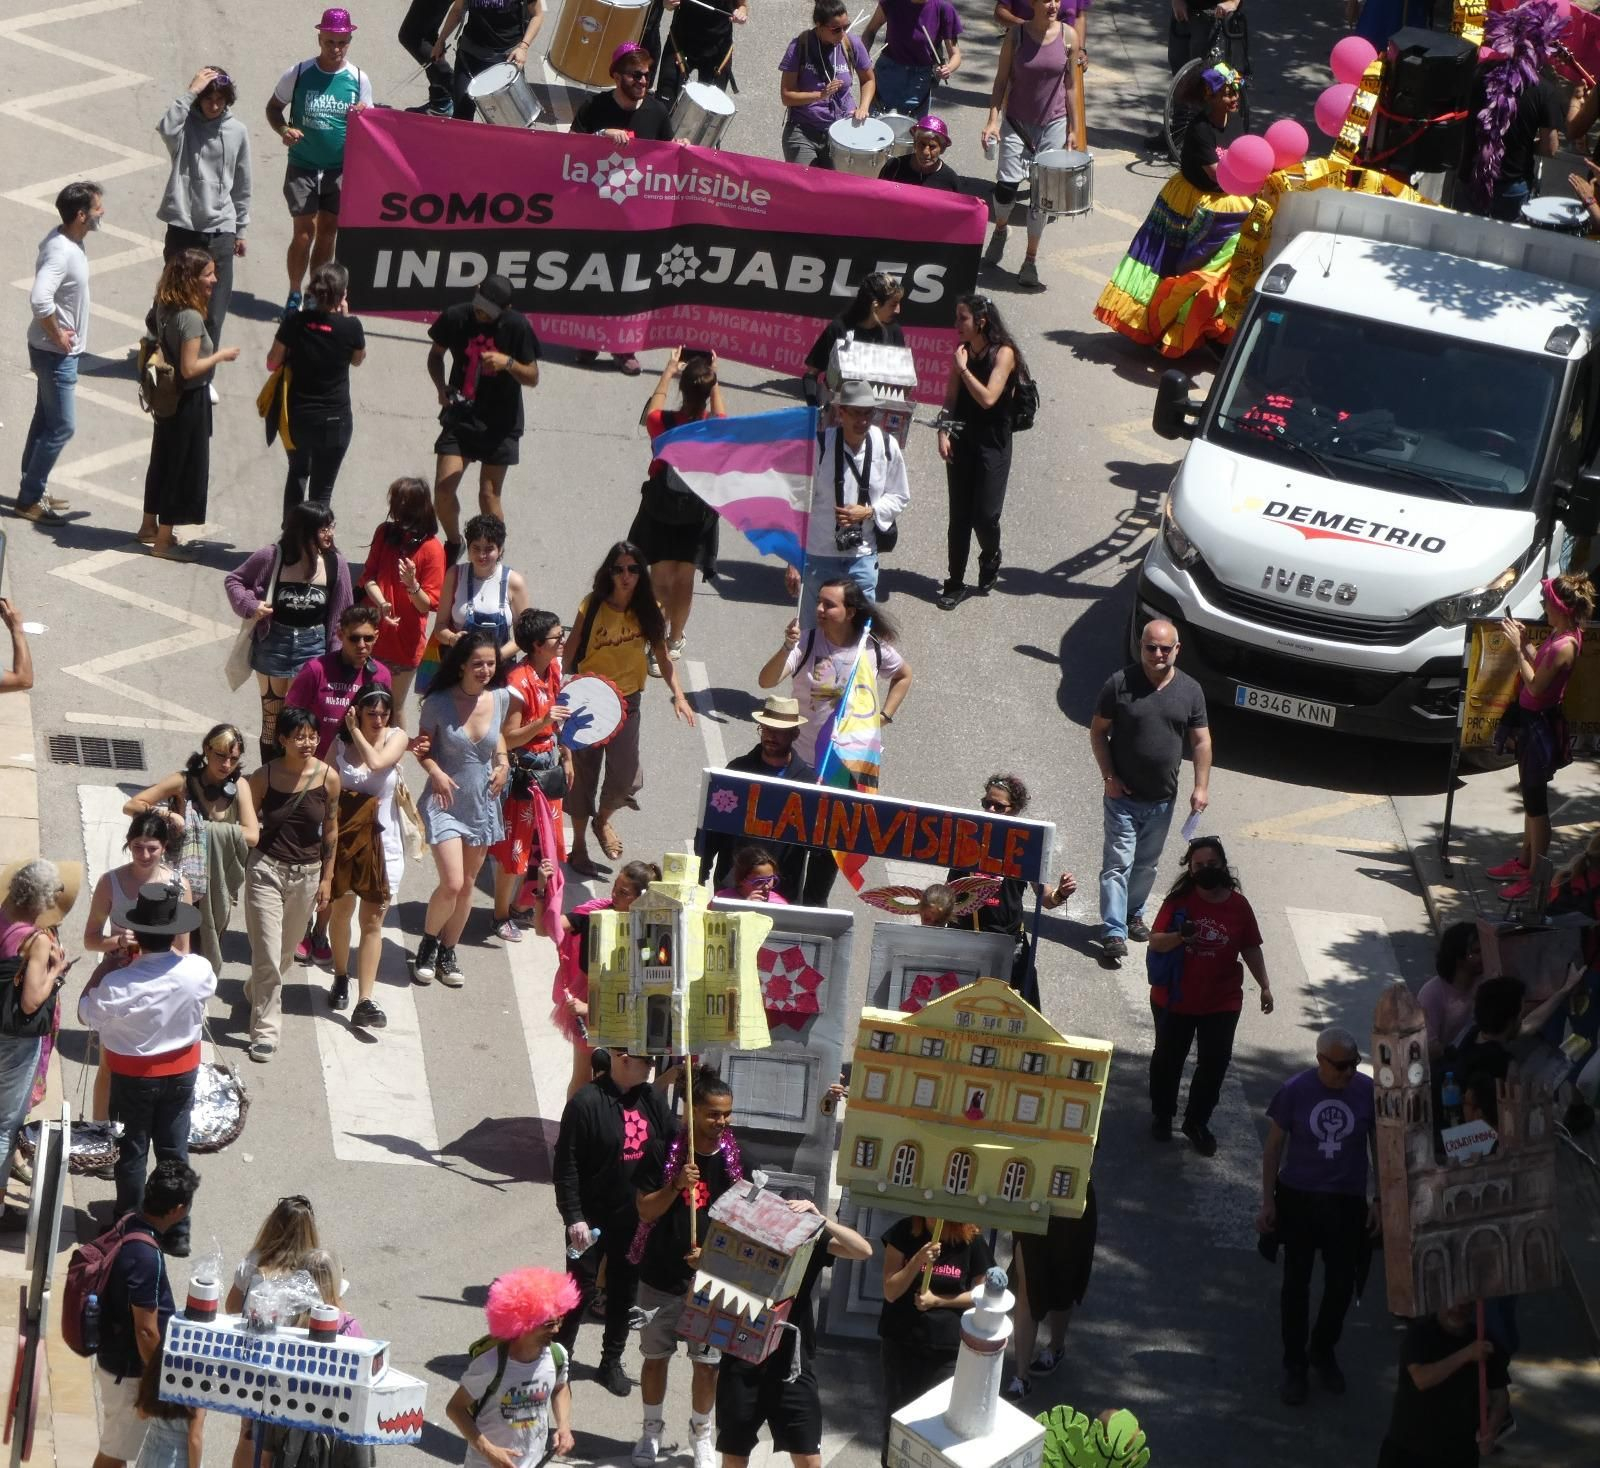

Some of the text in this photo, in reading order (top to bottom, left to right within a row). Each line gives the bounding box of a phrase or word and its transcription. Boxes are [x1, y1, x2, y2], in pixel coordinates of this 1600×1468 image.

[562, 153, 771, 206] la invisible
[379, 192, 554, 225] SOMOS
[1262, 500, 1447, 554] DEMETRIO
[1261, 565, 1358, 606] IVECO
[1247, 691, 1332, 724] 8346 KNN
